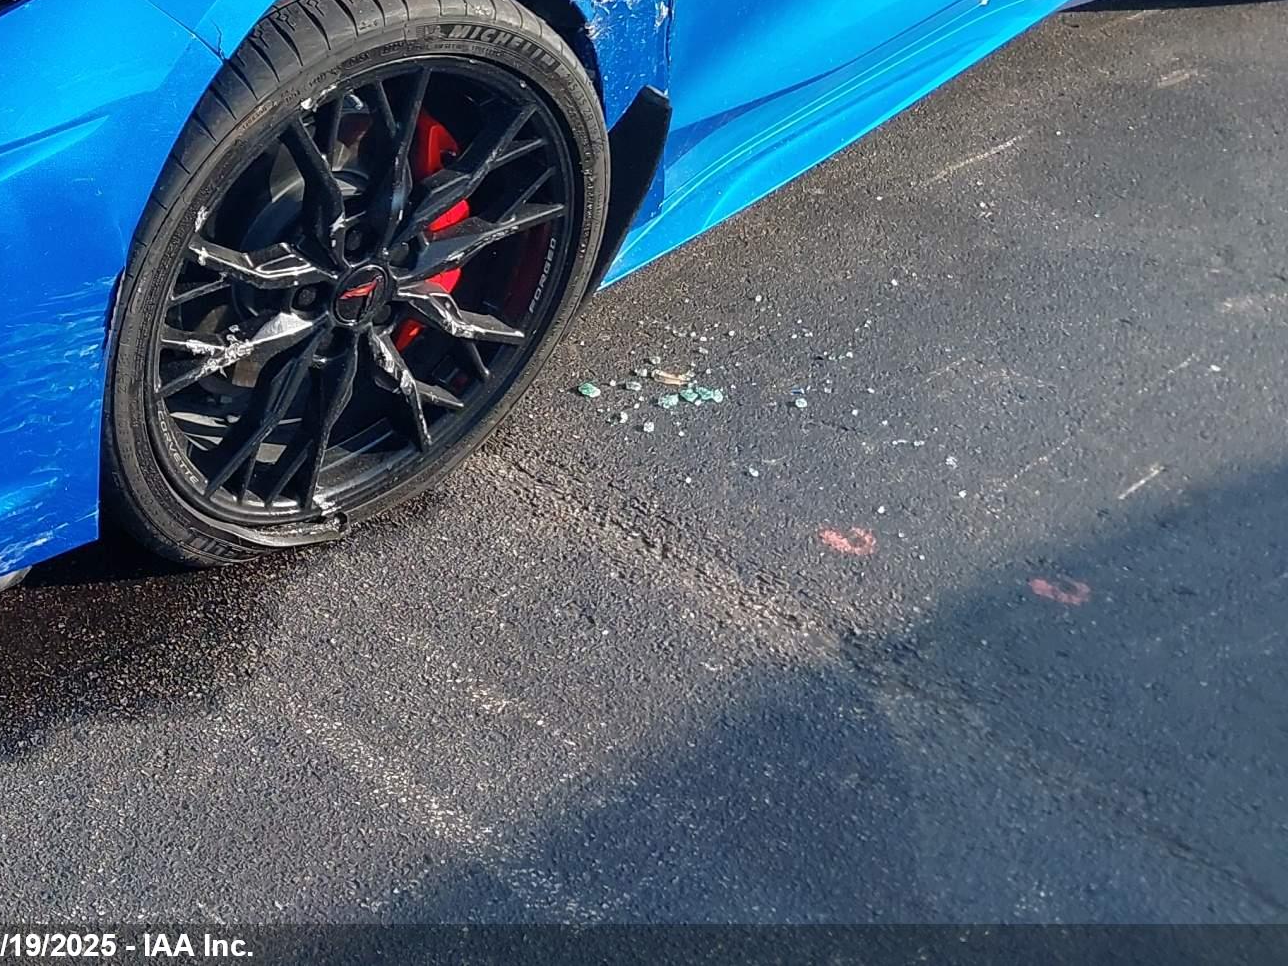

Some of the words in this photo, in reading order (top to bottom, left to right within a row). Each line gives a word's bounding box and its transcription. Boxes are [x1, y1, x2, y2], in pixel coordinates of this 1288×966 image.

[447, 25, 558, 75] MICHELIN
[528, 237, 556, 314] FORGED
[157, 410, 199, 483] CORVETTE
